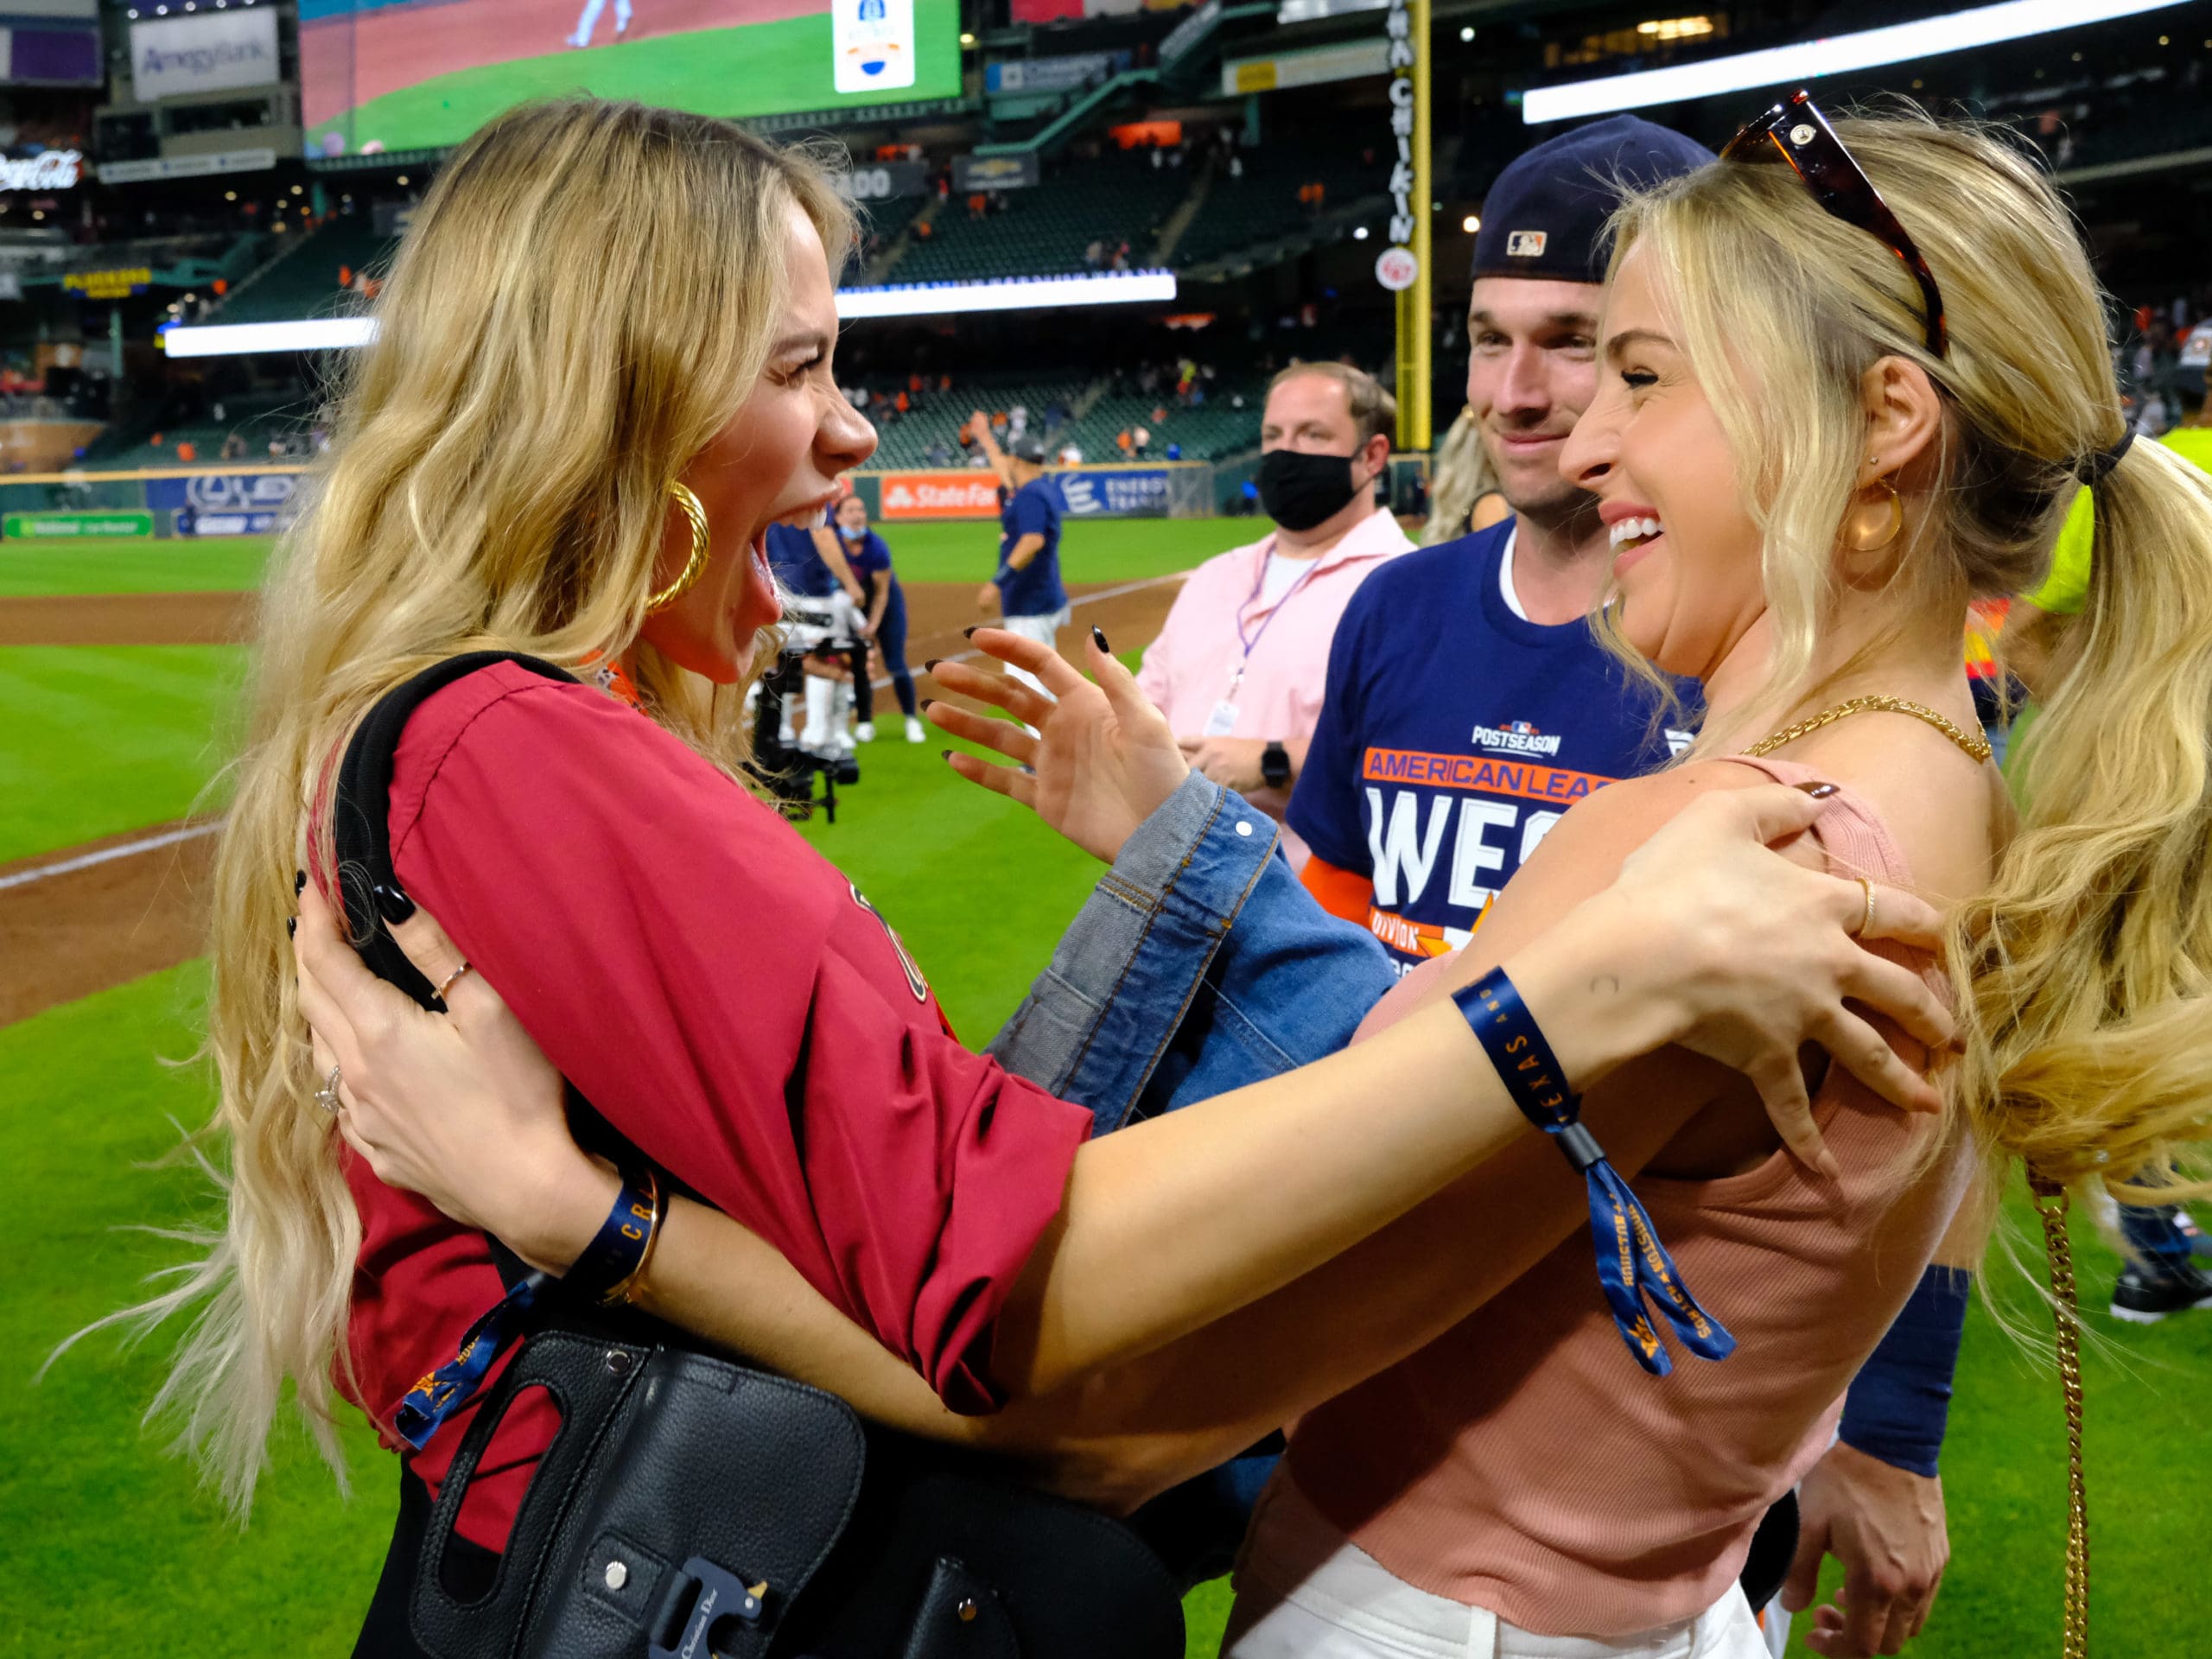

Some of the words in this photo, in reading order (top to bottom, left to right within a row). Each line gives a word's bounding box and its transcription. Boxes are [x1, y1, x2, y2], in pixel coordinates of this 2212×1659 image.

[1471, 725, 1560, 756] POSTSEASON
[1369, 752, 1522, 791] AMERICAN
[700, 1586, 718, 1615] Dior
